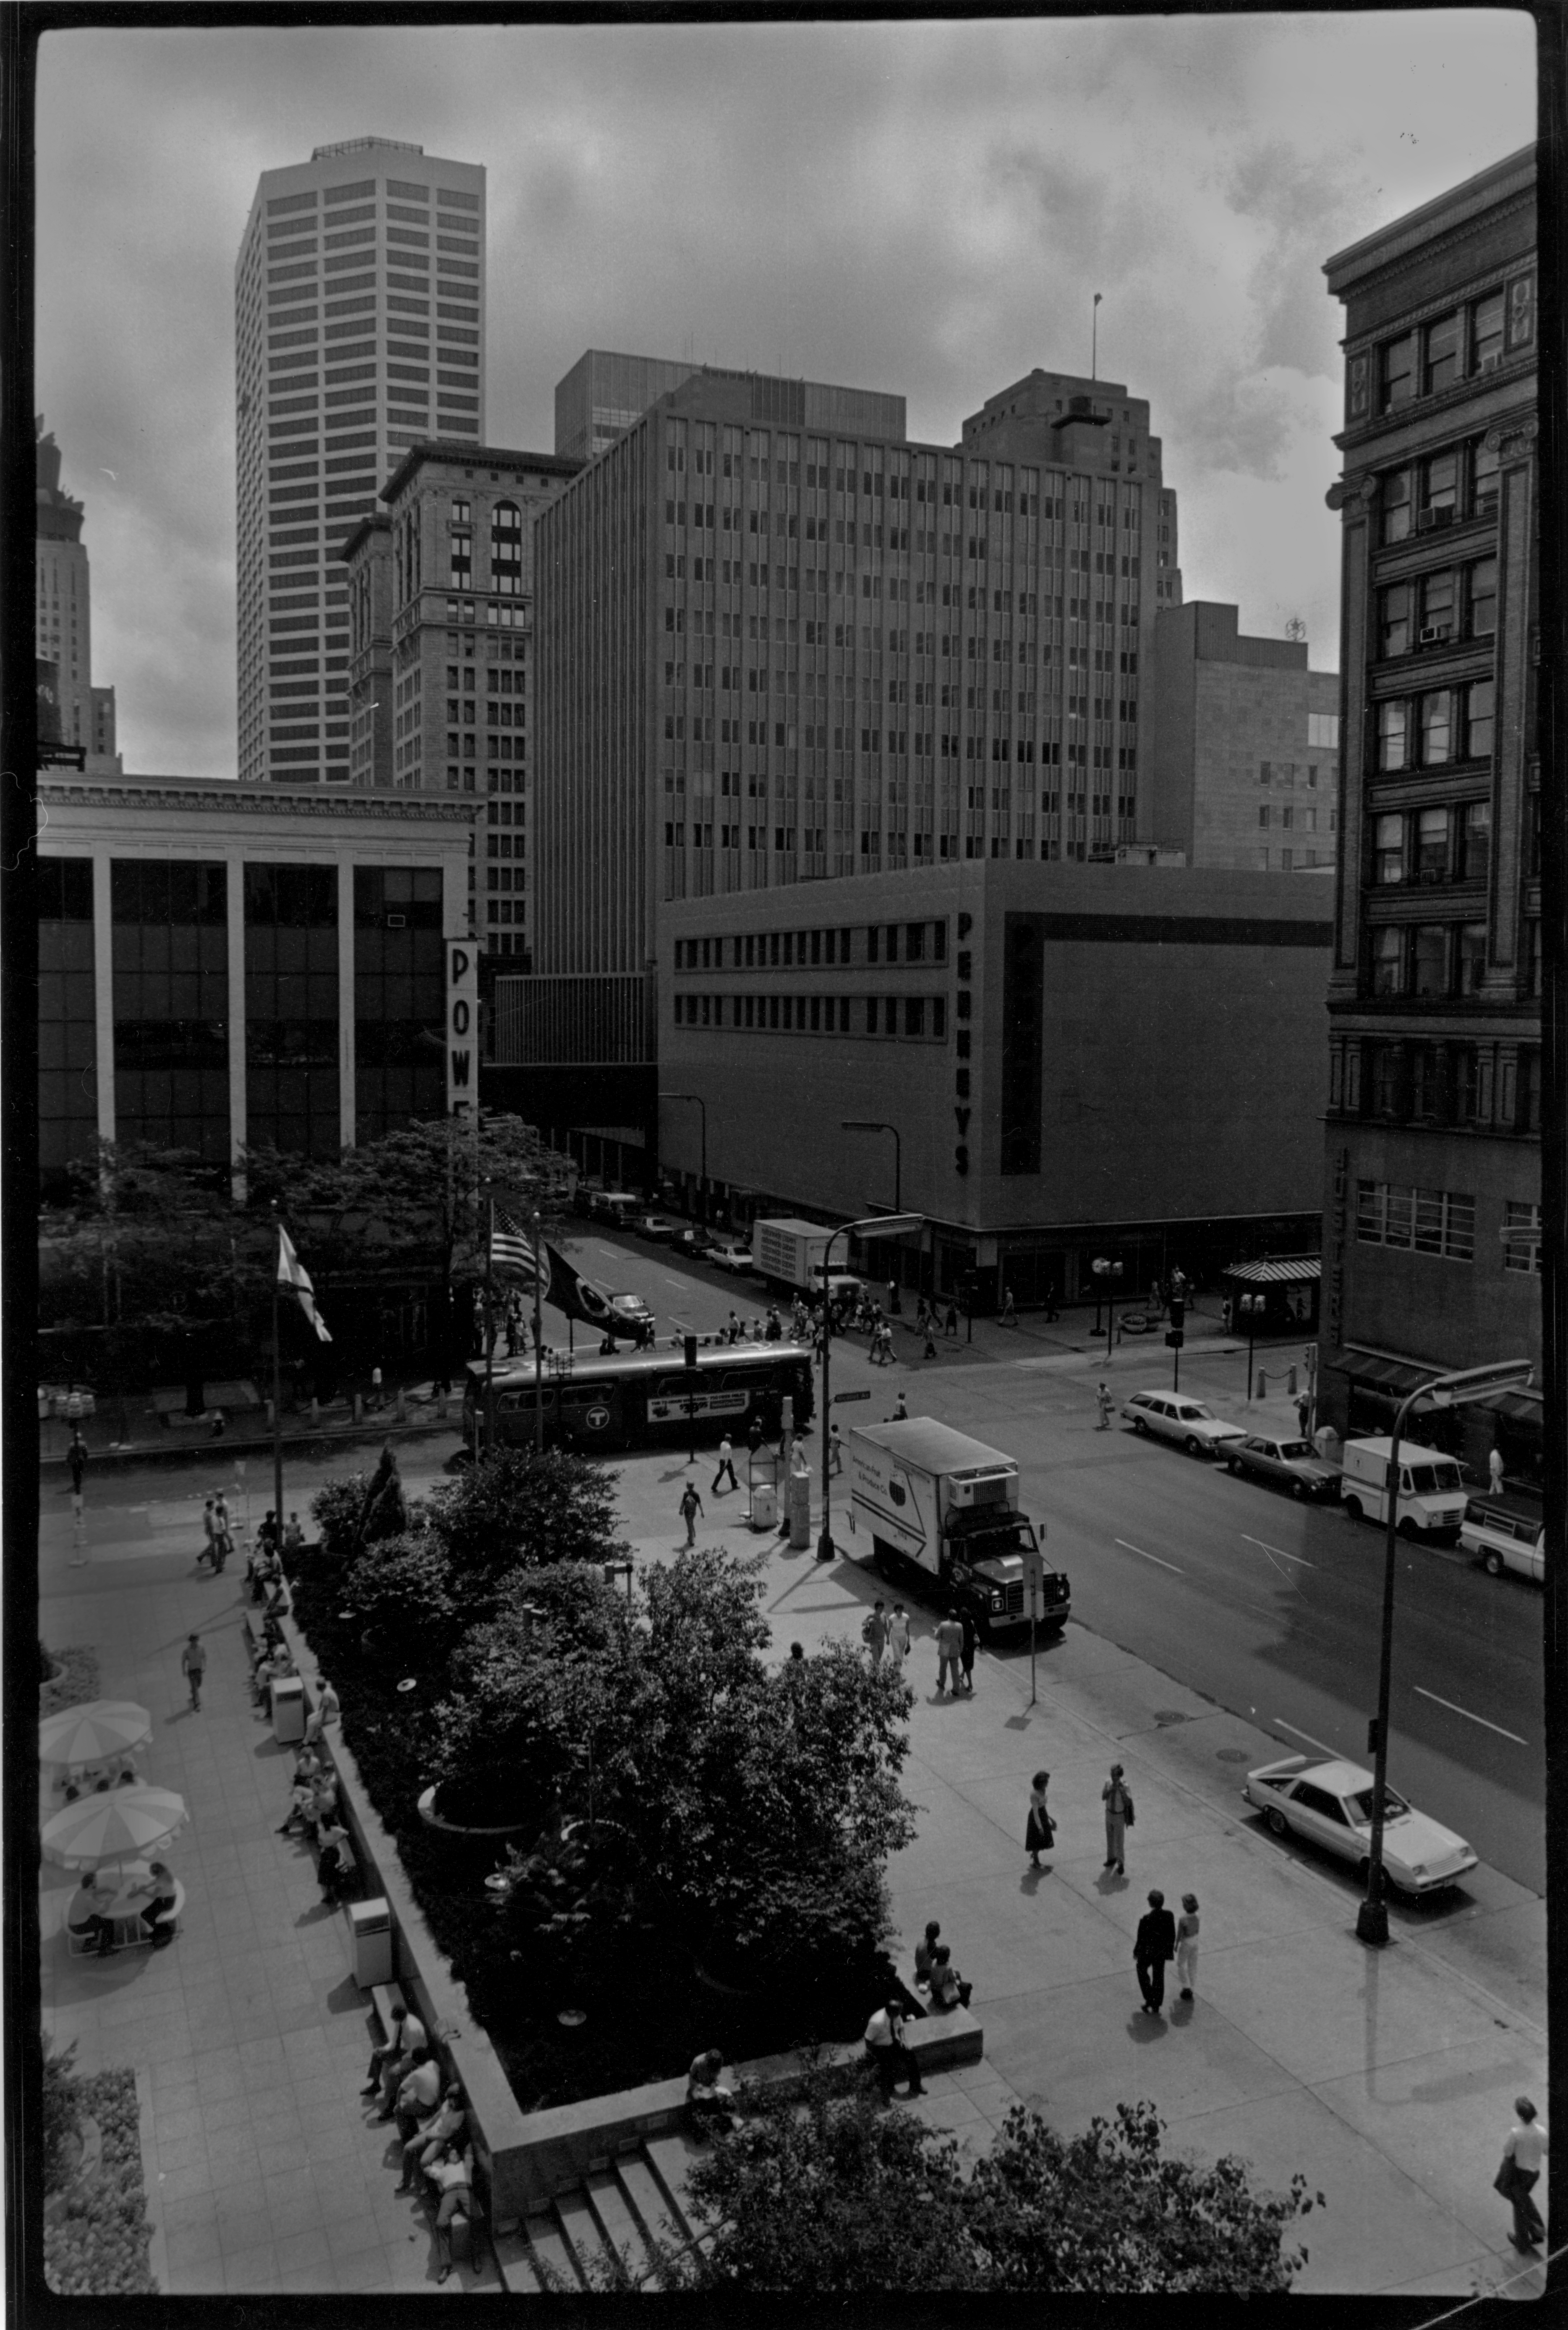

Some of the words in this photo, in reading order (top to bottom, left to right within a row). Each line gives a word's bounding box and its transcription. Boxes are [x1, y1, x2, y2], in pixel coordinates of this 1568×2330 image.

[761, 1228, 781, 1240] nationwide
[782, 1235, 797, 1245] papers
[761, 1236, 781, 1249] nationwide
[782, 1243, 796, 1254] papers
[761, 1244, 781, 1257] nationwide
[782, 1251, 796, 1262] papers
[761, 1252, 781, 1265] nationwide
[782, 1260, 796, 1271] papers
[760, 1260, 781, 1274] nationwide
[781, 1268, 796, 1279] papers
[590, 1412, 605, 1425] T
[853, 1455, 871, 1472] American
[870, 1465, 881, 1478] Fruit
[862, 1473, 880, 1491] Produce
